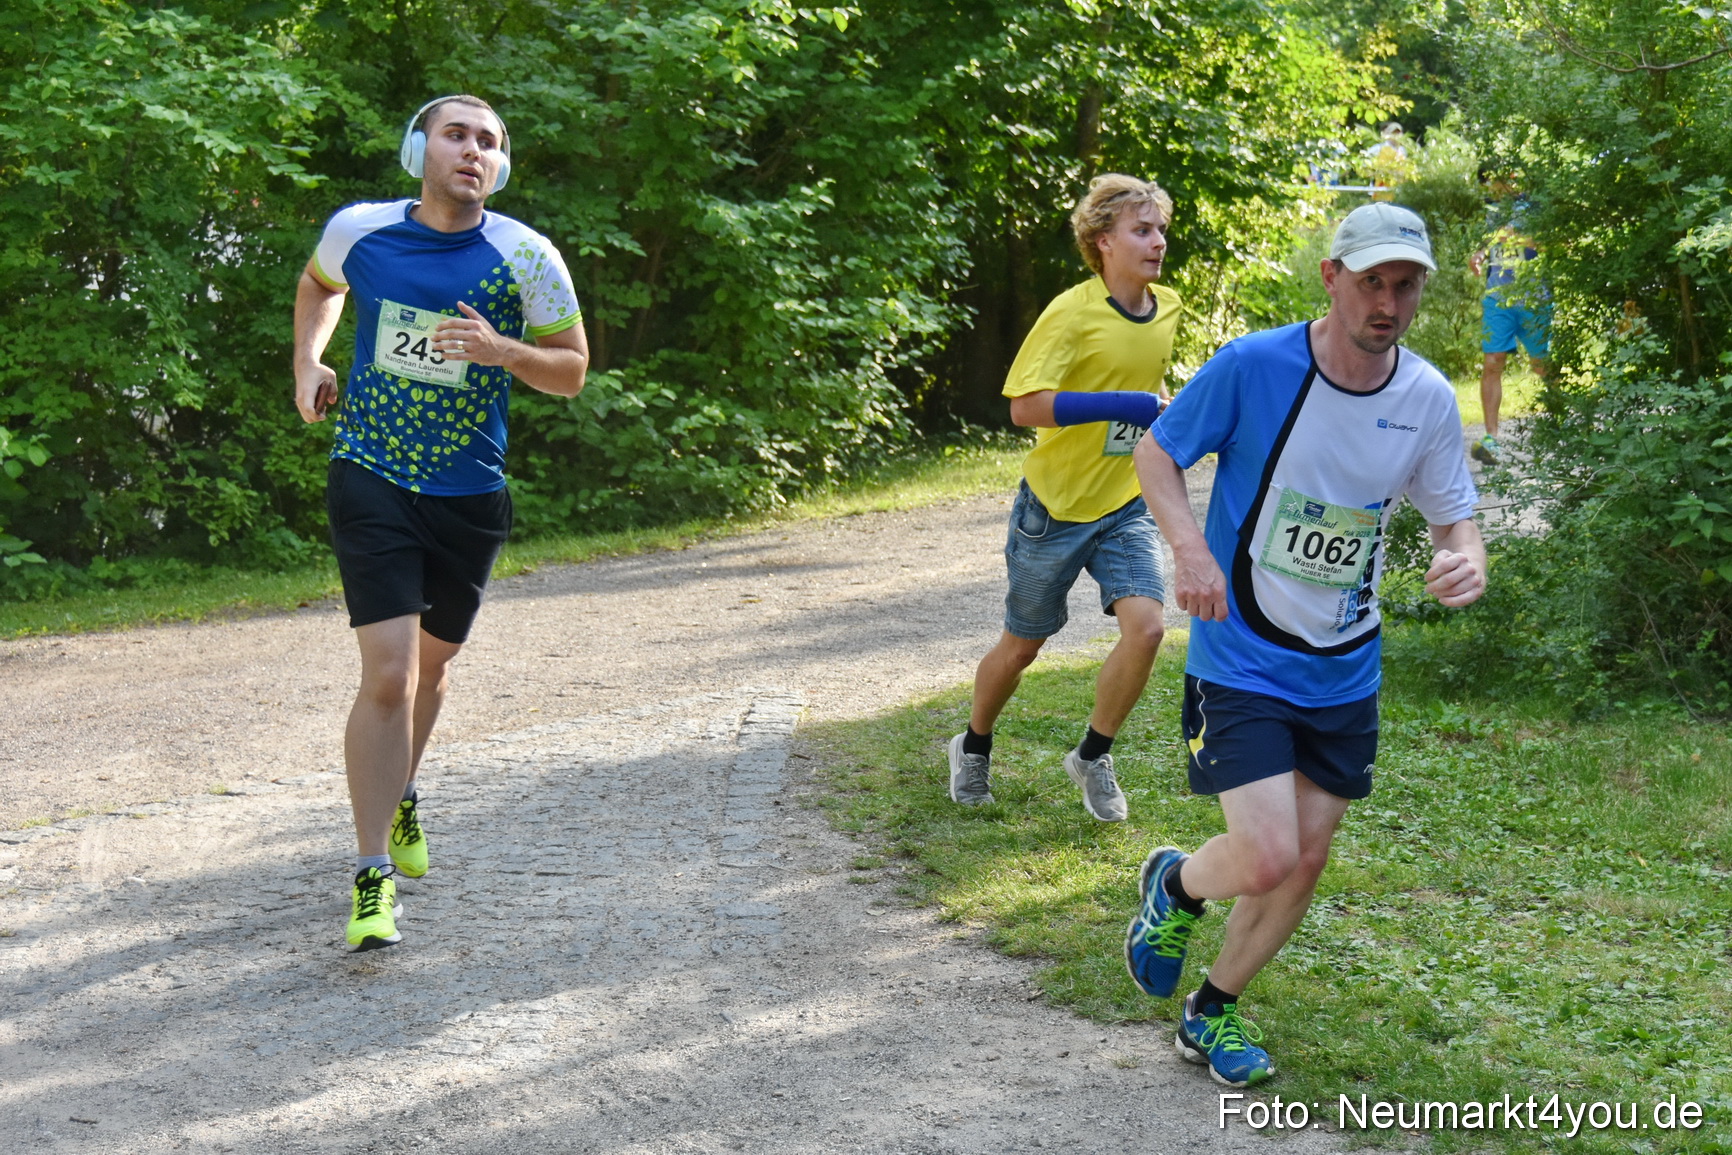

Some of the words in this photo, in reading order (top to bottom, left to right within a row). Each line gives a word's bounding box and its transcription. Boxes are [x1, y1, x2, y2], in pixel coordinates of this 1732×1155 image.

[384, 353, 417, 368] Nandrean
[418, 362, 454, 375] Laurentiu
[1292, 509, 1339, 530] firmenlauf
[1285, 524, 1362, 567] 1062
[1292, 556, 1316, 570] Wastl
[1318, 563, 1342, 575] Stefan
[1300, 568, 1322, 578] HUBER
